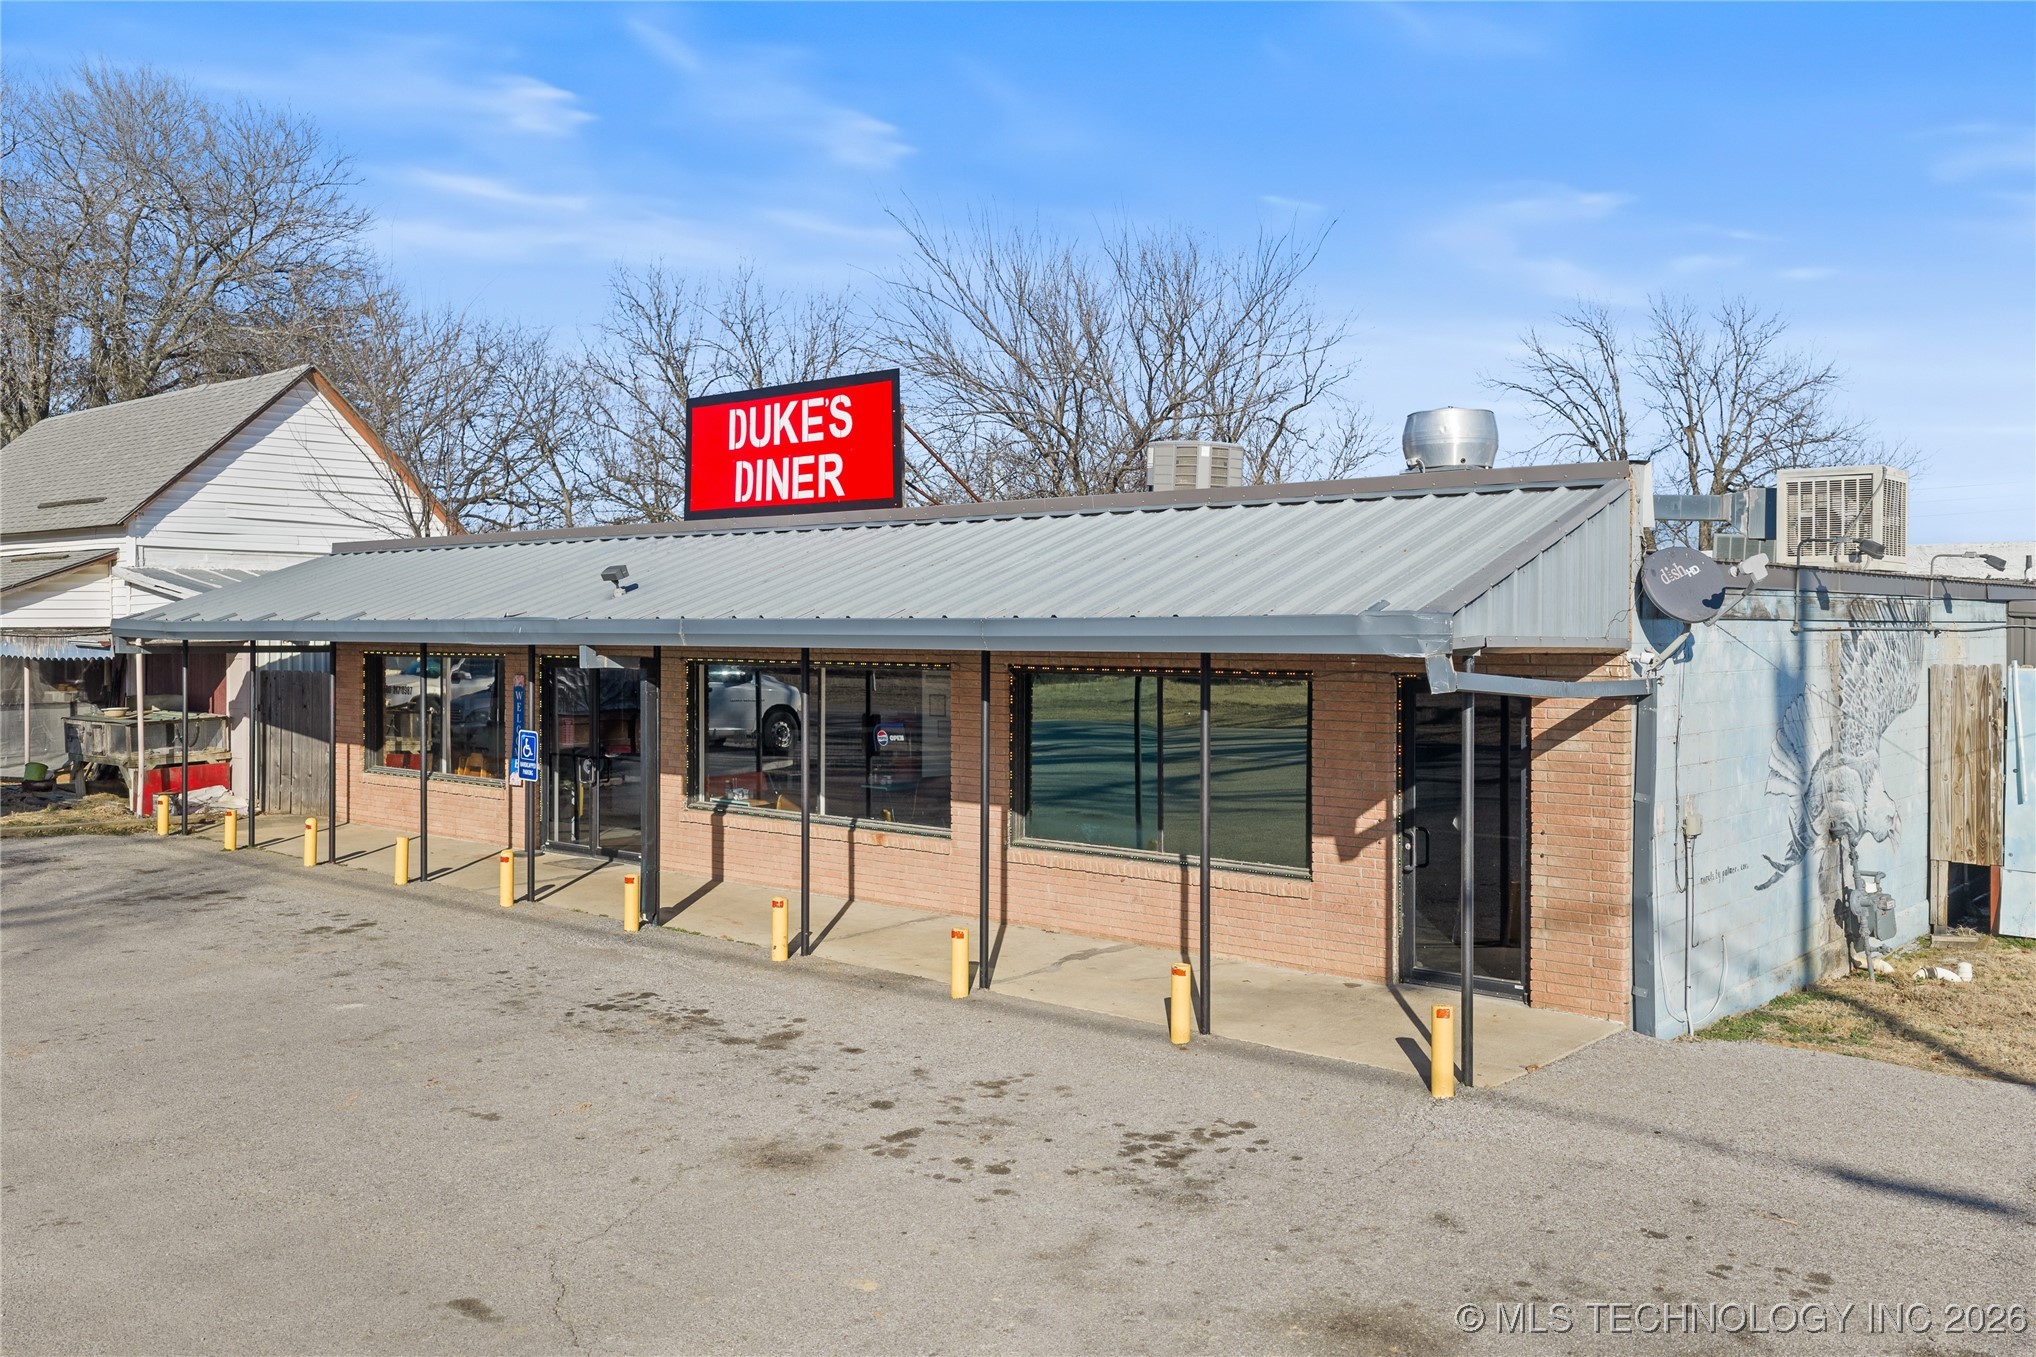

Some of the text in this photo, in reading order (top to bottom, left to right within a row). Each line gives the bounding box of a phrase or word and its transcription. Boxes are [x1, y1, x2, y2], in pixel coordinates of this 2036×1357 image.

[728, 394, 853, 451] DUKE'S
[734, 453, 845, 503] DINER
[889, 734, 905, 742] OPEN
